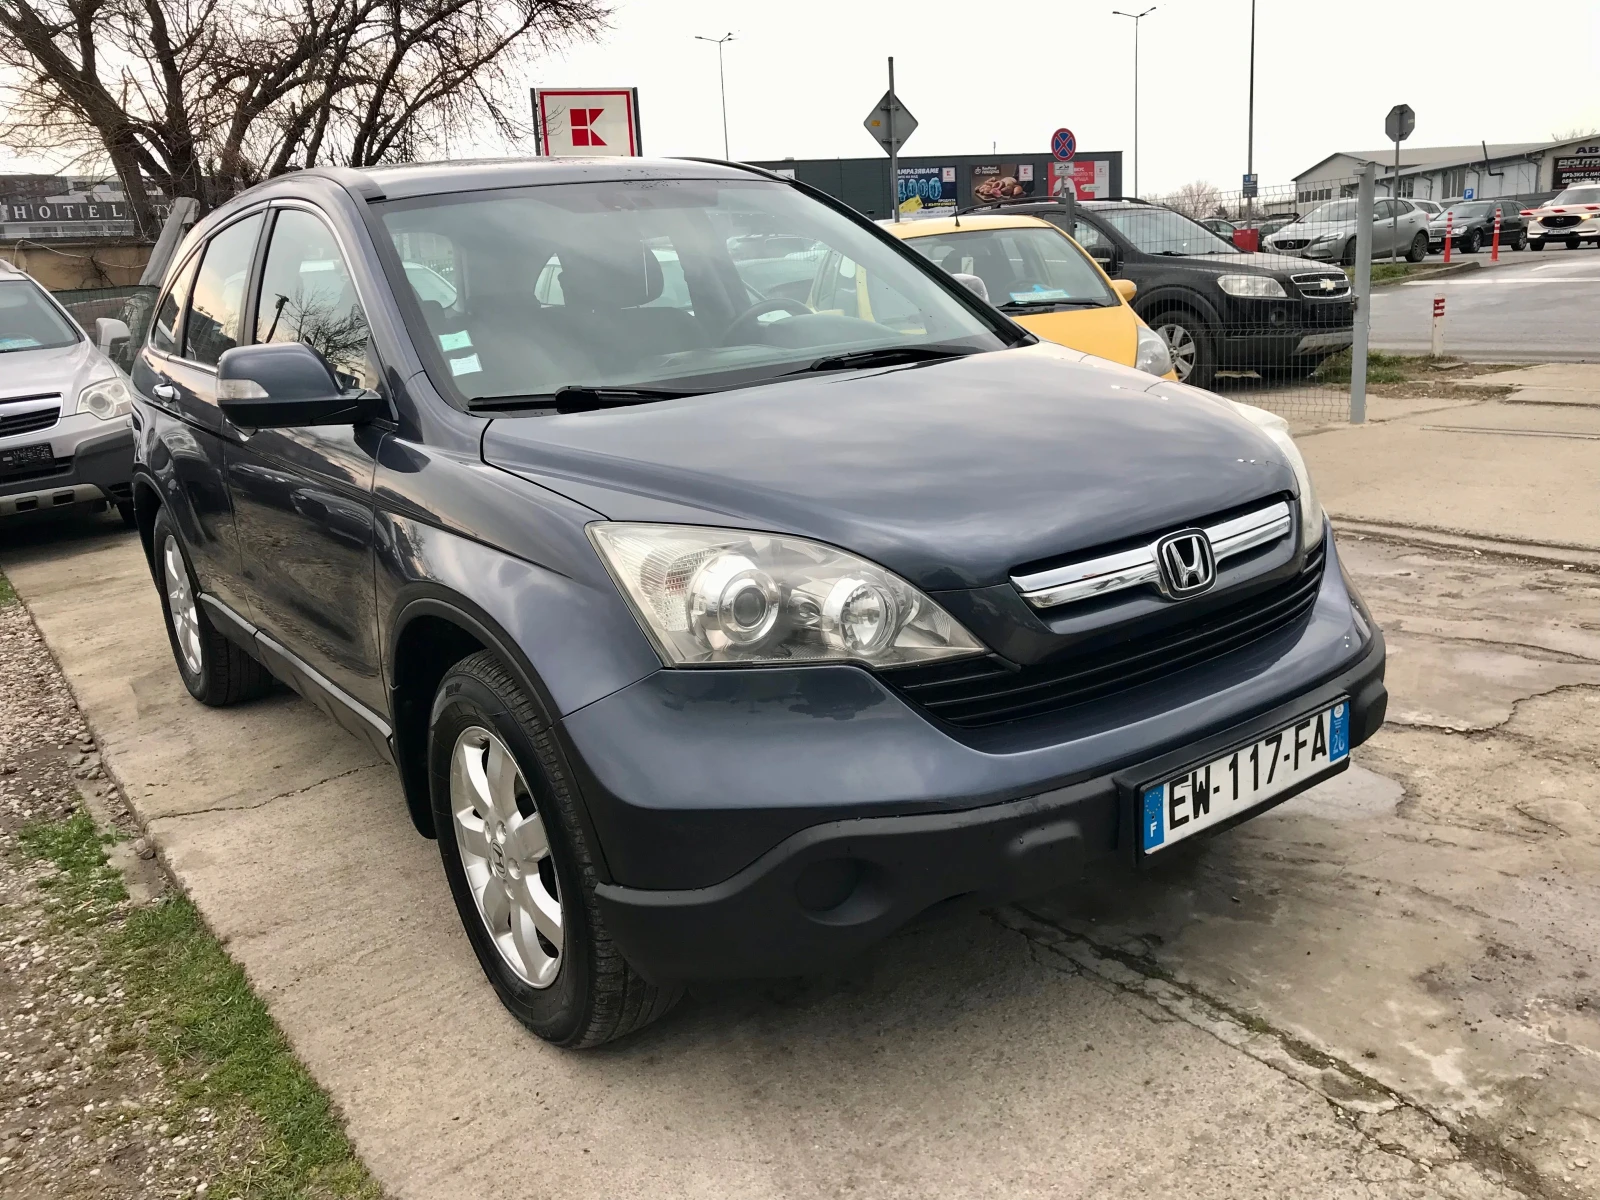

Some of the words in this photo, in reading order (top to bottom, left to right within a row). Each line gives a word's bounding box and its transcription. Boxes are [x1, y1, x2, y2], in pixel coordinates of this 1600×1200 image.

[897, 167, 939, 175] АМРАЗЯВАМЕ
[14, 203, 123, 219] HOTEL
[1168, 714, 1327, 831] EW-117-FA
[1150, 821, 1158, 837] F
